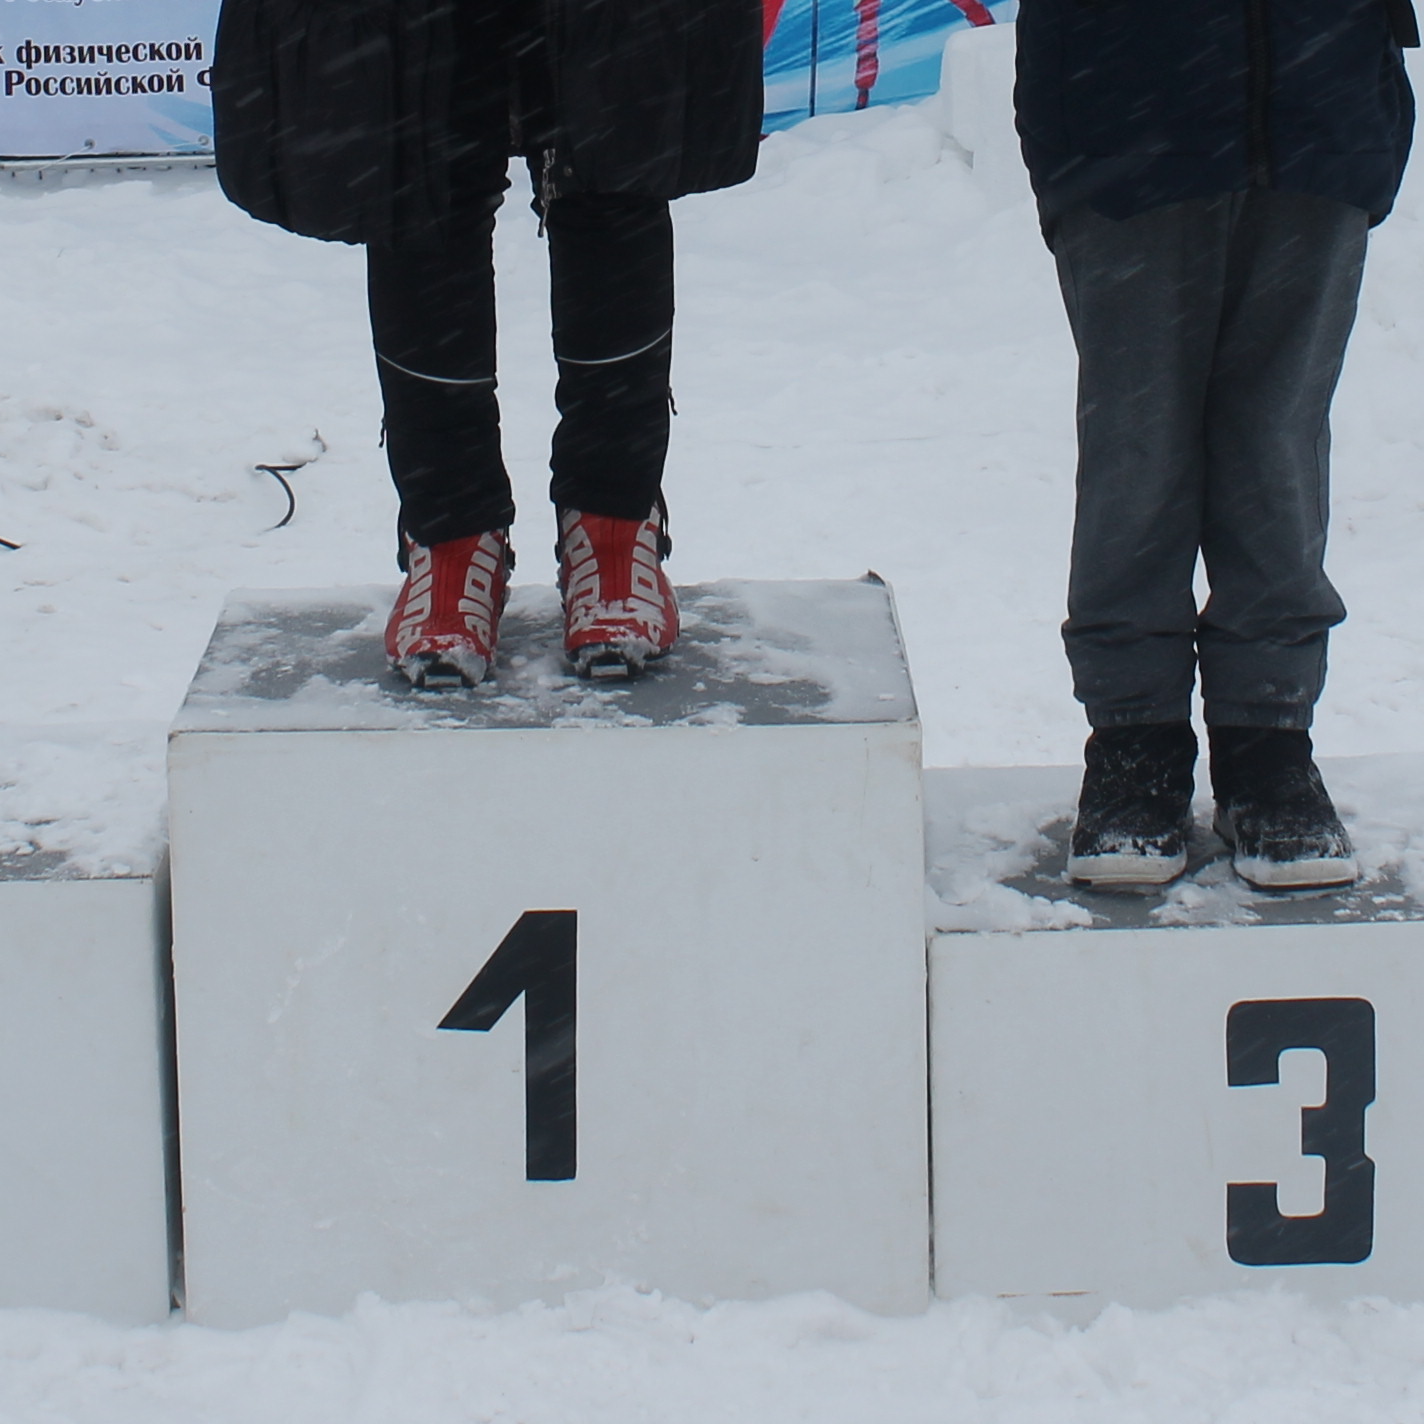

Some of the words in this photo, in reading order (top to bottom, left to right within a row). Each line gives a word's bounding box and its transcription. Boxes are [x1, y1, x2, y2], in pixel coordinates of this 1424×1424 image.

[5, 69, 184, 96] Российской
[16, 37, 202, 69] физической
[436, 909, 578, 1182] 1
[1226, 997, 1377, 1267] 3
